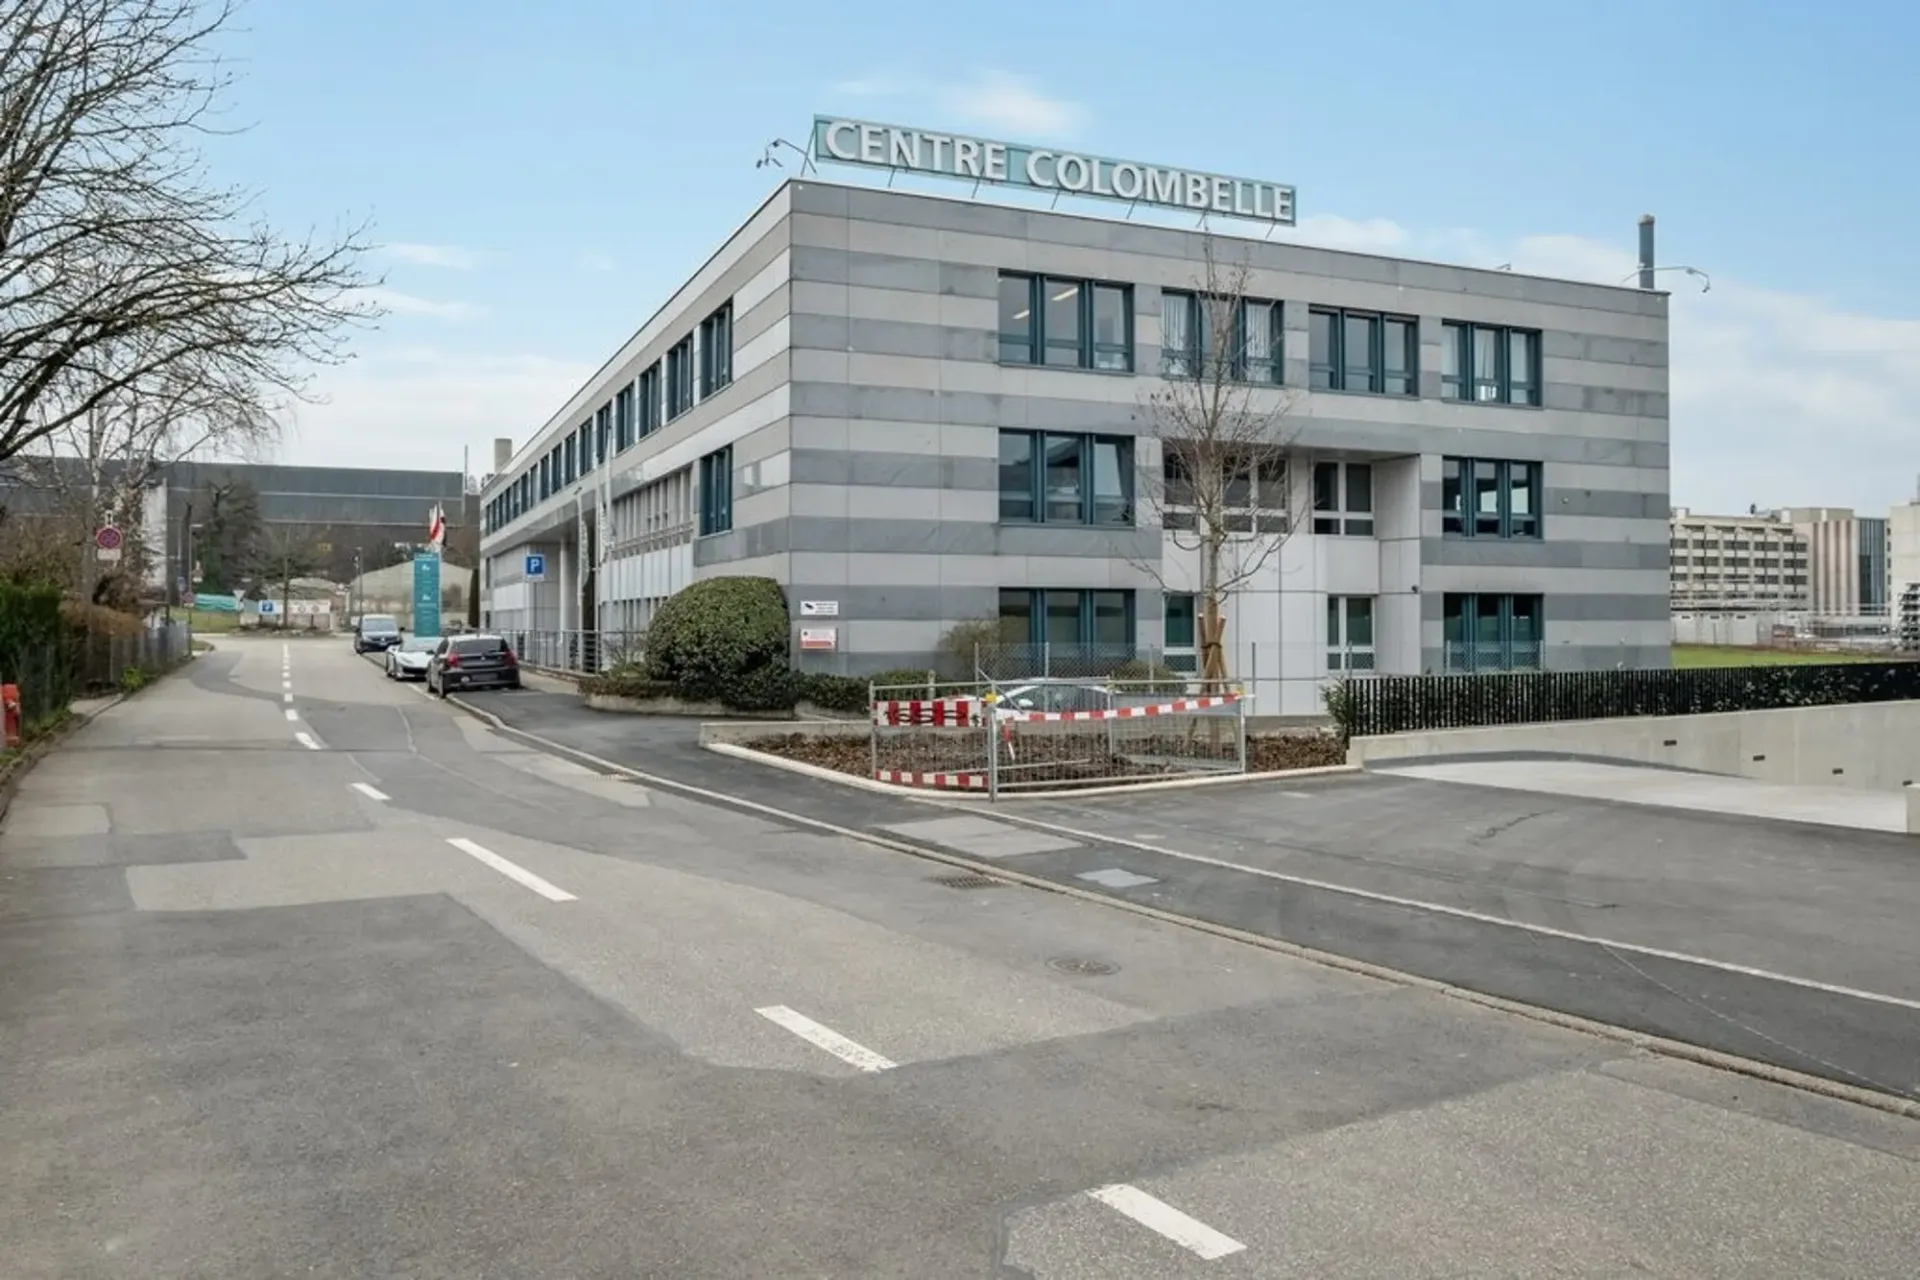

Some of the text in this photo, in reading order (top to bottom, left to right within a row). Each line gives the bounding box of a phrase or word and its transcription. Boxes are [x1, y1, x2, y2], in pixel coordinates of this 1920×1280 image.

[826, 120, 1292, 220] CENTRE COLOMBELLE
[530, 558, 540, 572] P
